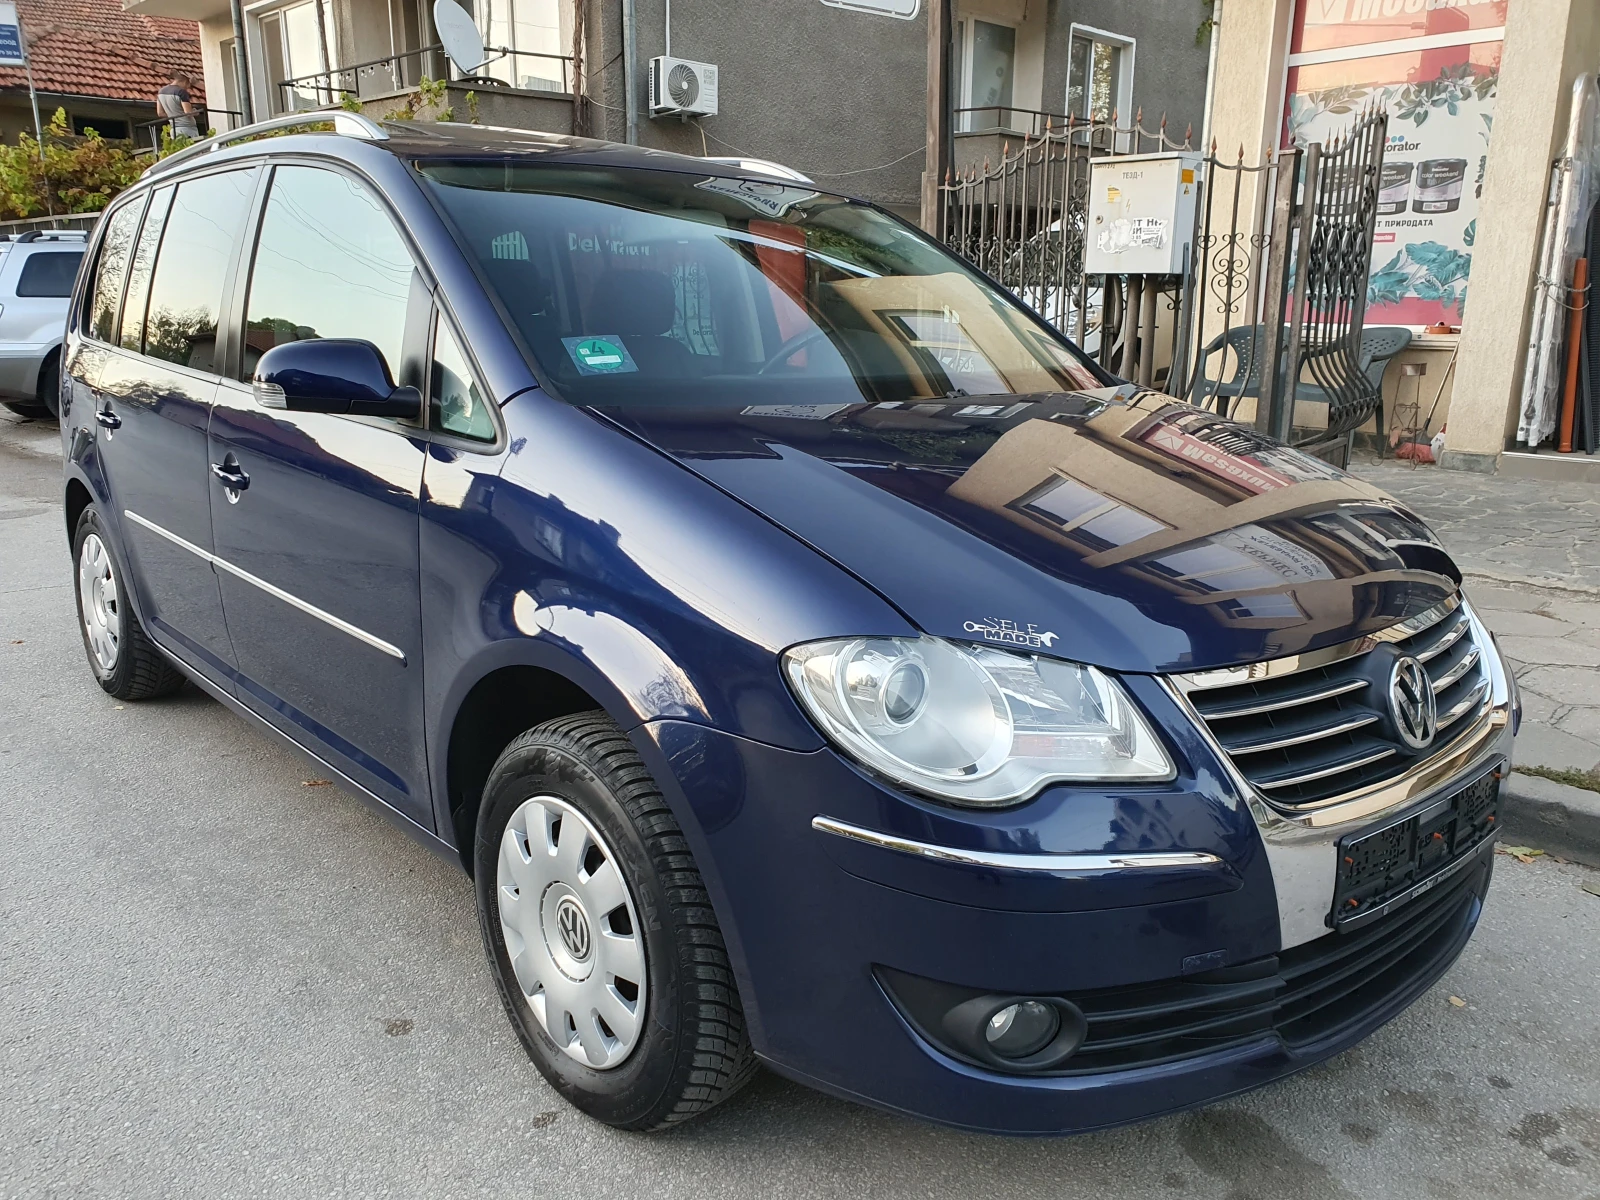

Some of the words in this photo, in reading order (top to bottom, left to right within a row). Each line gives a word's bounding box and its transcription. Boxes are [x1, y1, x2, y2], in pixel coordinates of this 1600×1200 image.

[1384, 219, 1434, 228] ПРИРОДАТА
[592, 341, 605, 355] 4
[983, 616, 1038, 635] SELF
[984, 628, 1041, 647] MADE
[606, 811, 662, 931] NEXEN
